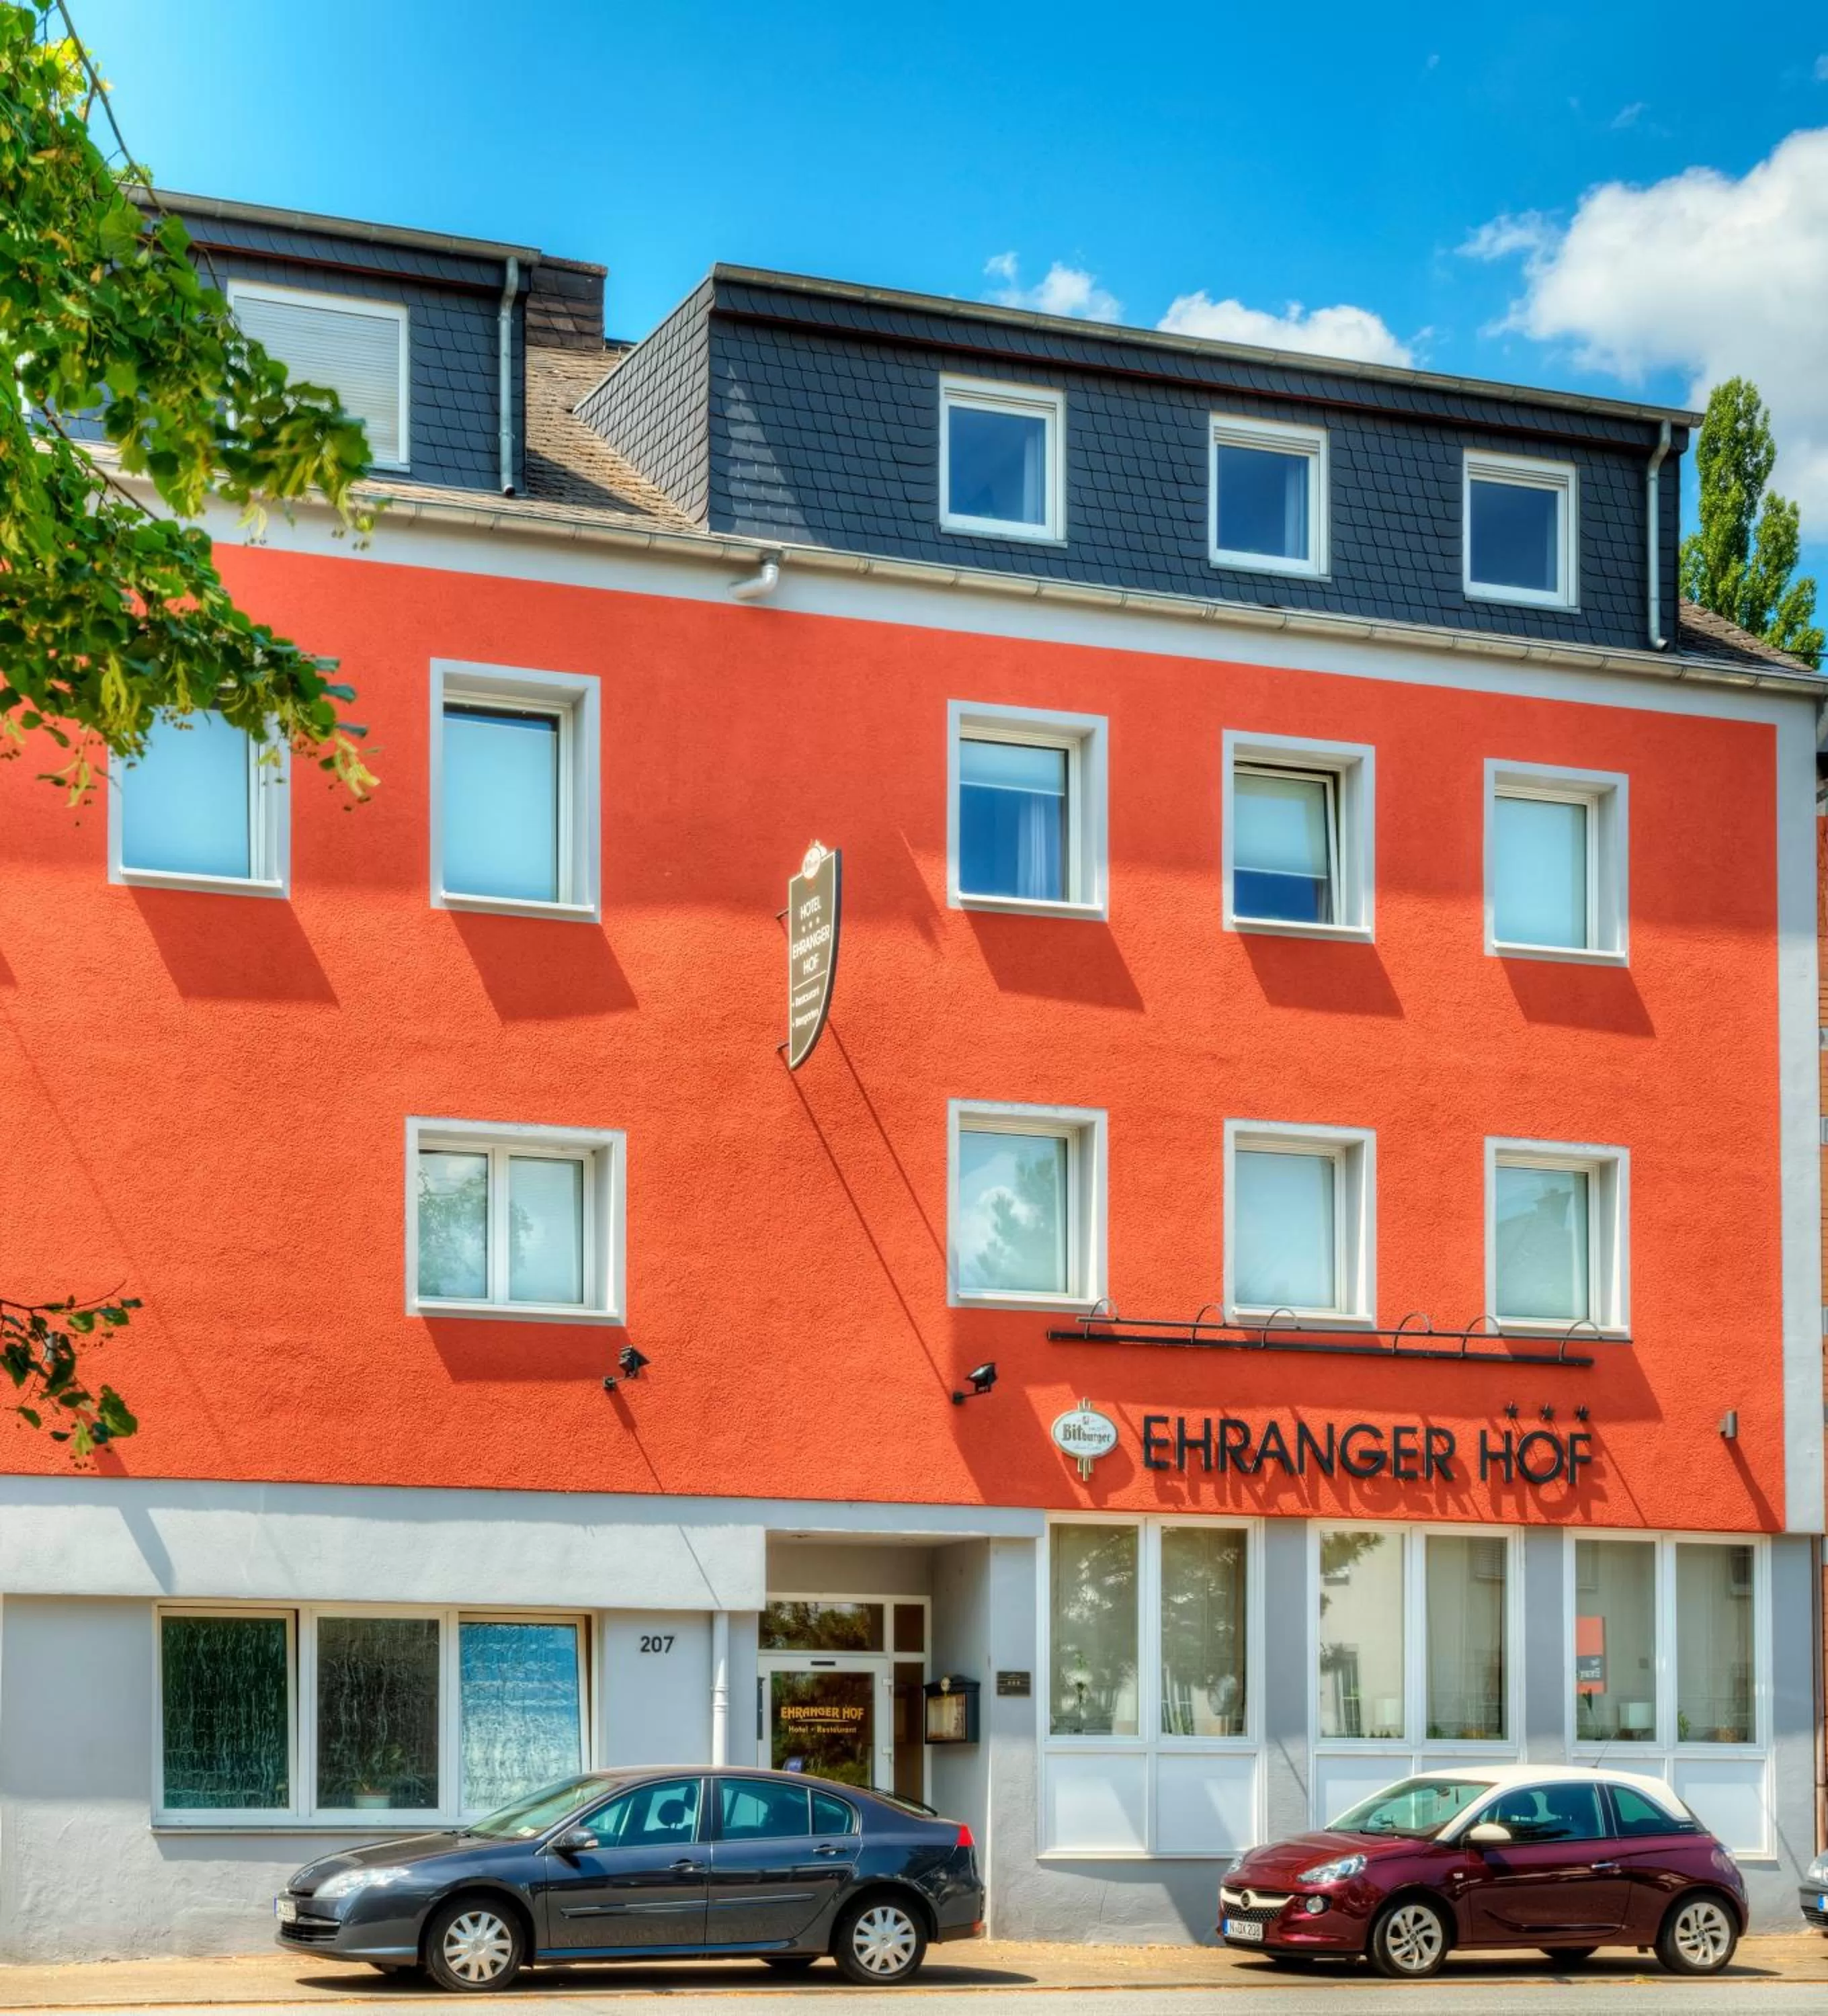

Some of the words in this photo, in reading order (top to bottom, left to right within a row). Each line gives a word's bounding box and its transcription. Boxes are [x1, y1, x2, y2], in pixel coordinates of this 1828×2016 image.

[800, 895, 821, 920] HOTEL
[792, 925, 829, 960] EHRANGER
[803, 953, 819, 974] HOF
[1062, 1423, 1111, 1443] Bitburger
[1143, 1415, 1455, 1482] EHRANGER
[1480, 1428, 1592, 1485] HOF
[640, 1635, 675, 1654] 207
[780, 1707, 839, 1719] EHRANGER
[841, 1707, 864, 1720] HOF
[788, 1725, 808, 1734] Hotel
[817, 1725, 857, 1733] Restaurant
